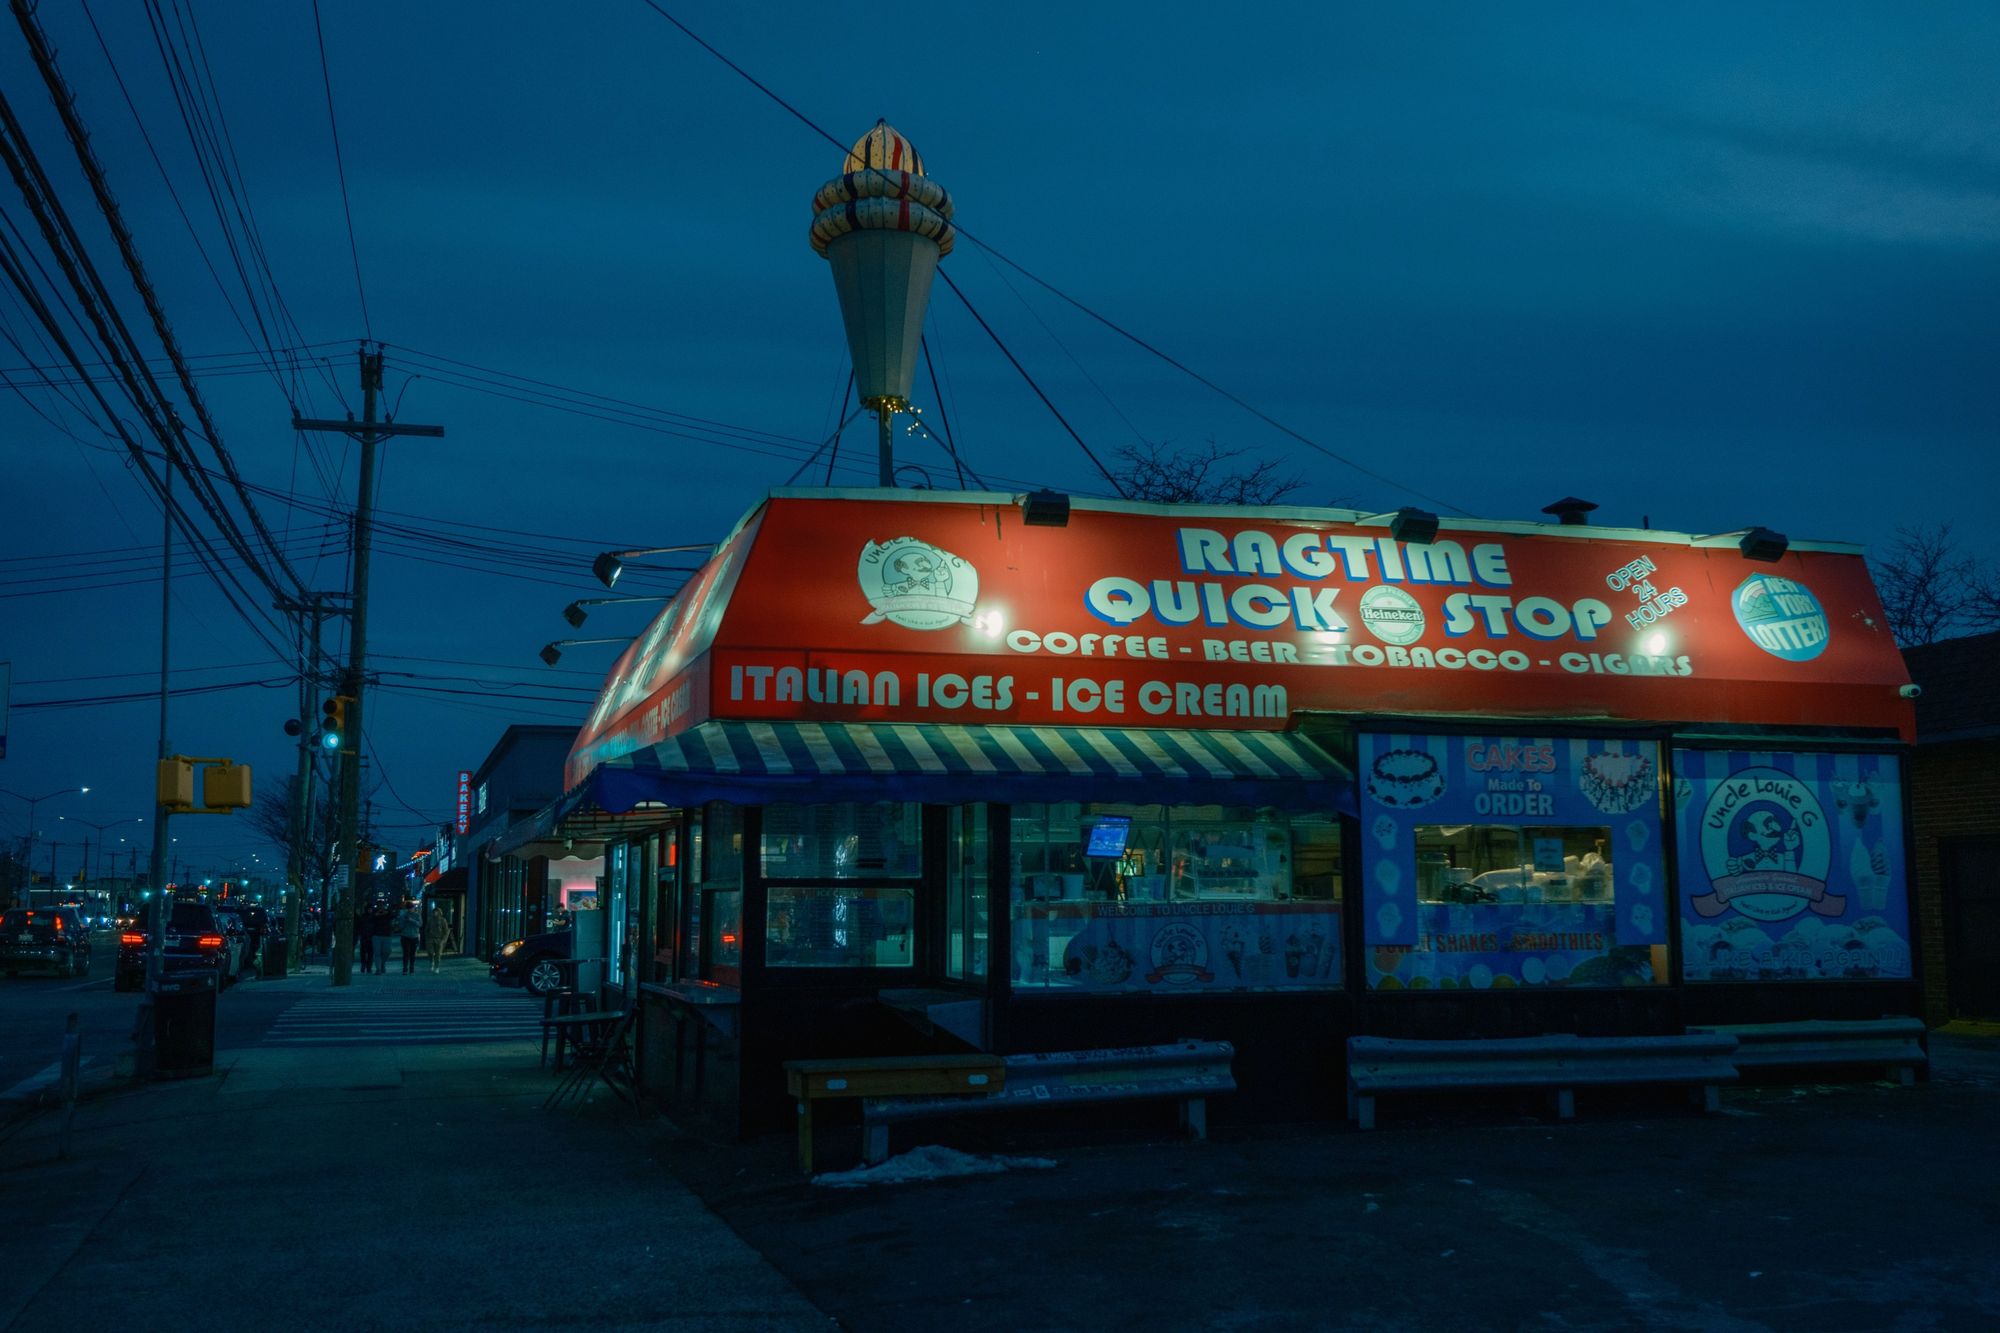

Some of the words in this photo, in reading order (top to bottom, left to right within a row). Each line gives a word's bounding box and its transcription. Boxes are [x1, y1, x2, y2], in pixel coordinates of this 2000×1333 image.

[1176, 527, 1512, 587] RAGTIME
[1606, 554, 1658, 592] OPEN
[1084, 577, 1349, 631] QUICK
[1442, 593, 1612, 641] STOP
[1624, 587, 1688, 632] HOURS
[1632, 579, 1658, 603] 24
[1363, 607, 1421, 621] Heineken
[1748, 613, 1827, 652] LOTTERY
[1006, 630, 1170, 660] COFFEE
[1202, 639, 1301, 664] BEER
[1334, 645, 1530, 671] TOBACCO
[1559, 652, 1693, 676] CIGARS
[730, 665, 901, 706] ITALIAN
[917, 673, 1014, 710] ICES
[1051, 678, 1125, 713] ICE
[1138, 680, 1288, 718] CREAM
[1467, 744, 1557, 772] CAKES
[459, 772, 469, 834] BAKERY
[1488, 778, 1524, 792] Made
[1527, 777, 1542, 791] To
[1709, 783, 1751, 829] Uncle
[1753, 775, 1801, 809] Louie
[1801, 810, 1819, 827] G
[1474, 793, 1555, 816] ORDER
[1098, 905, 1153, 916] WELCOME
[1156, 904, 1170, 915] TO
[1173, 903, 1210, 915] UNCLE
[1212, 903, 1244, 914] LOUIE
[1435, 933, 1498, 951] SHAKES
[161, 984, 181, 992] NYC
